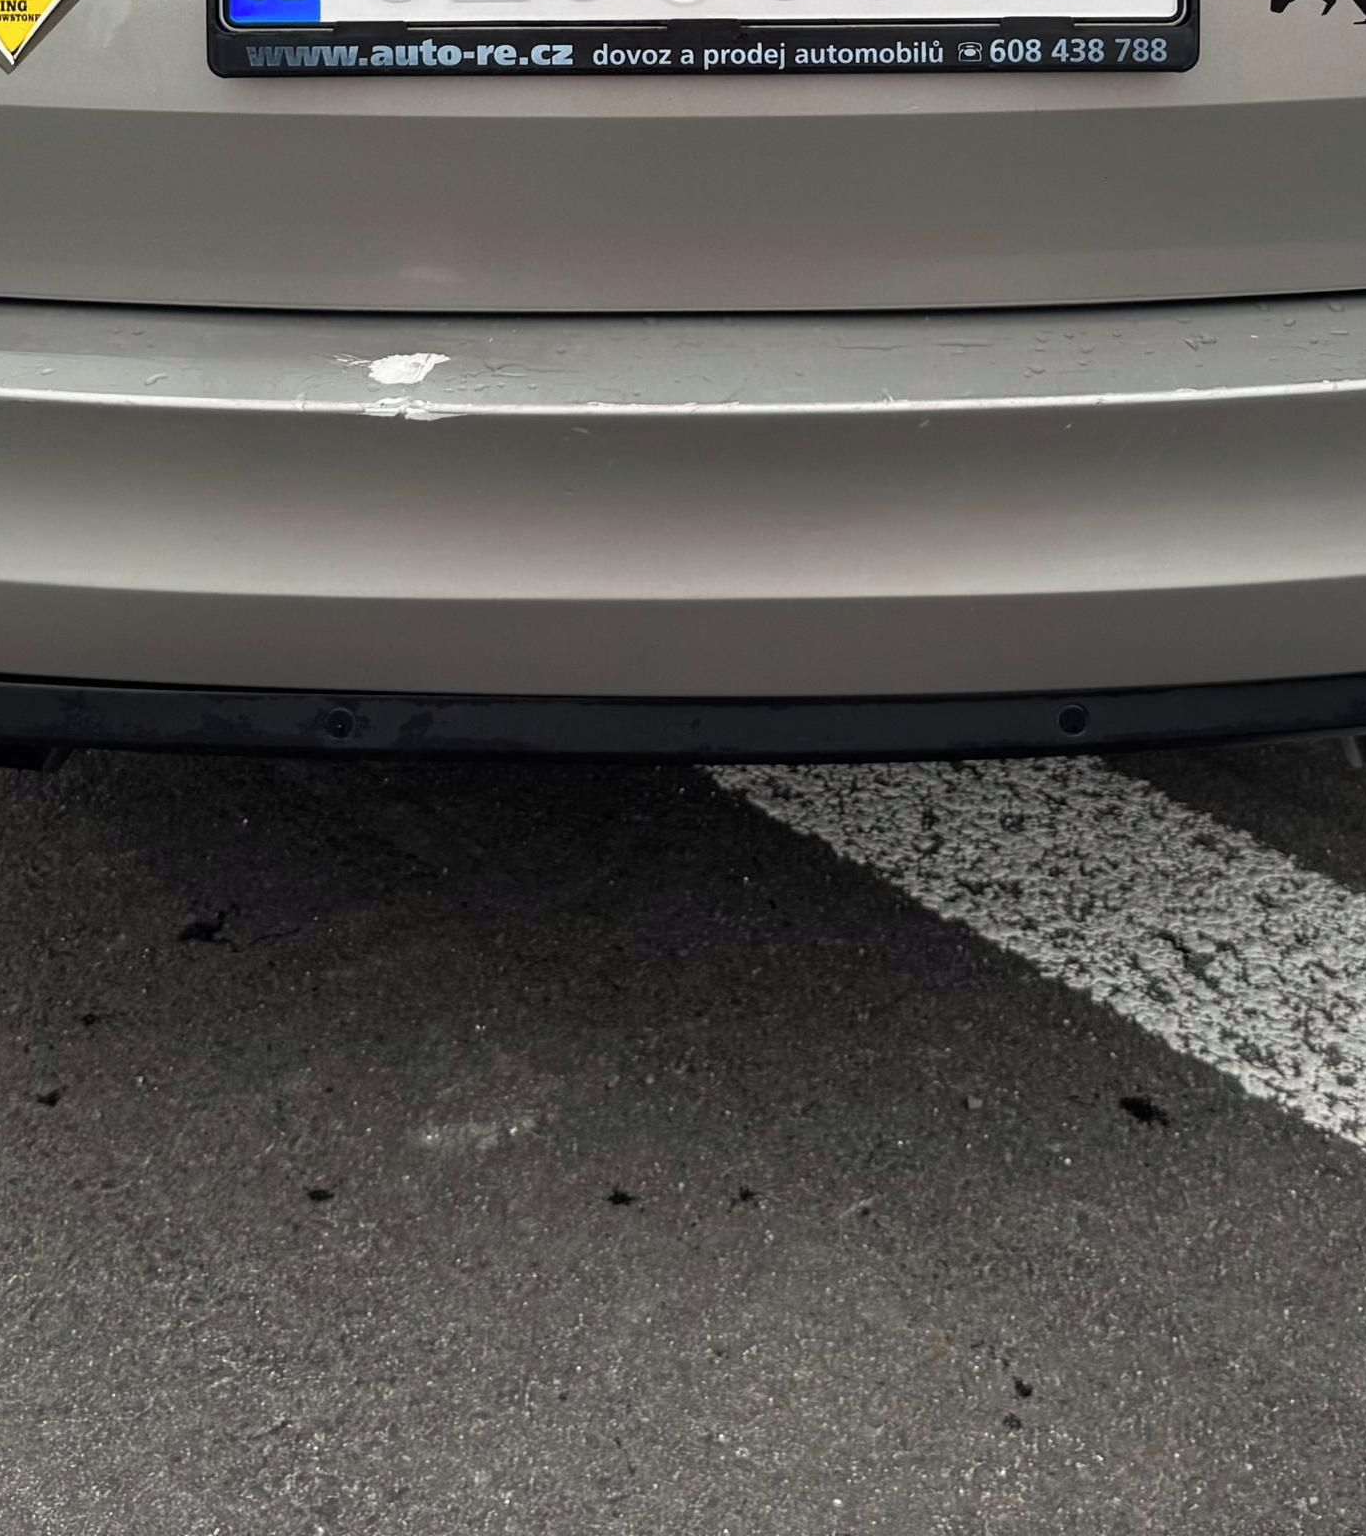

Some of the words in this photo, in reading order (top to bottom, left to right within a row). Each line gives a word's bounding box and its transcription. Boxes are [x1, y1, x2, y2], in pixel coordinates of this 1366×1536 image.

[246, 38, 574, 66] www.auto-re.cz
[592, 43, 672, 65] dovoz
[680, 48, 695, 65] a
[703, 43, 786, 70] prodej
[794, 40, 944, 65] automobilů
[989, 39, 1042, 63] 608
[1051, 38, 1105, 63] 438
[1114, 38, 1168, 62] 788
